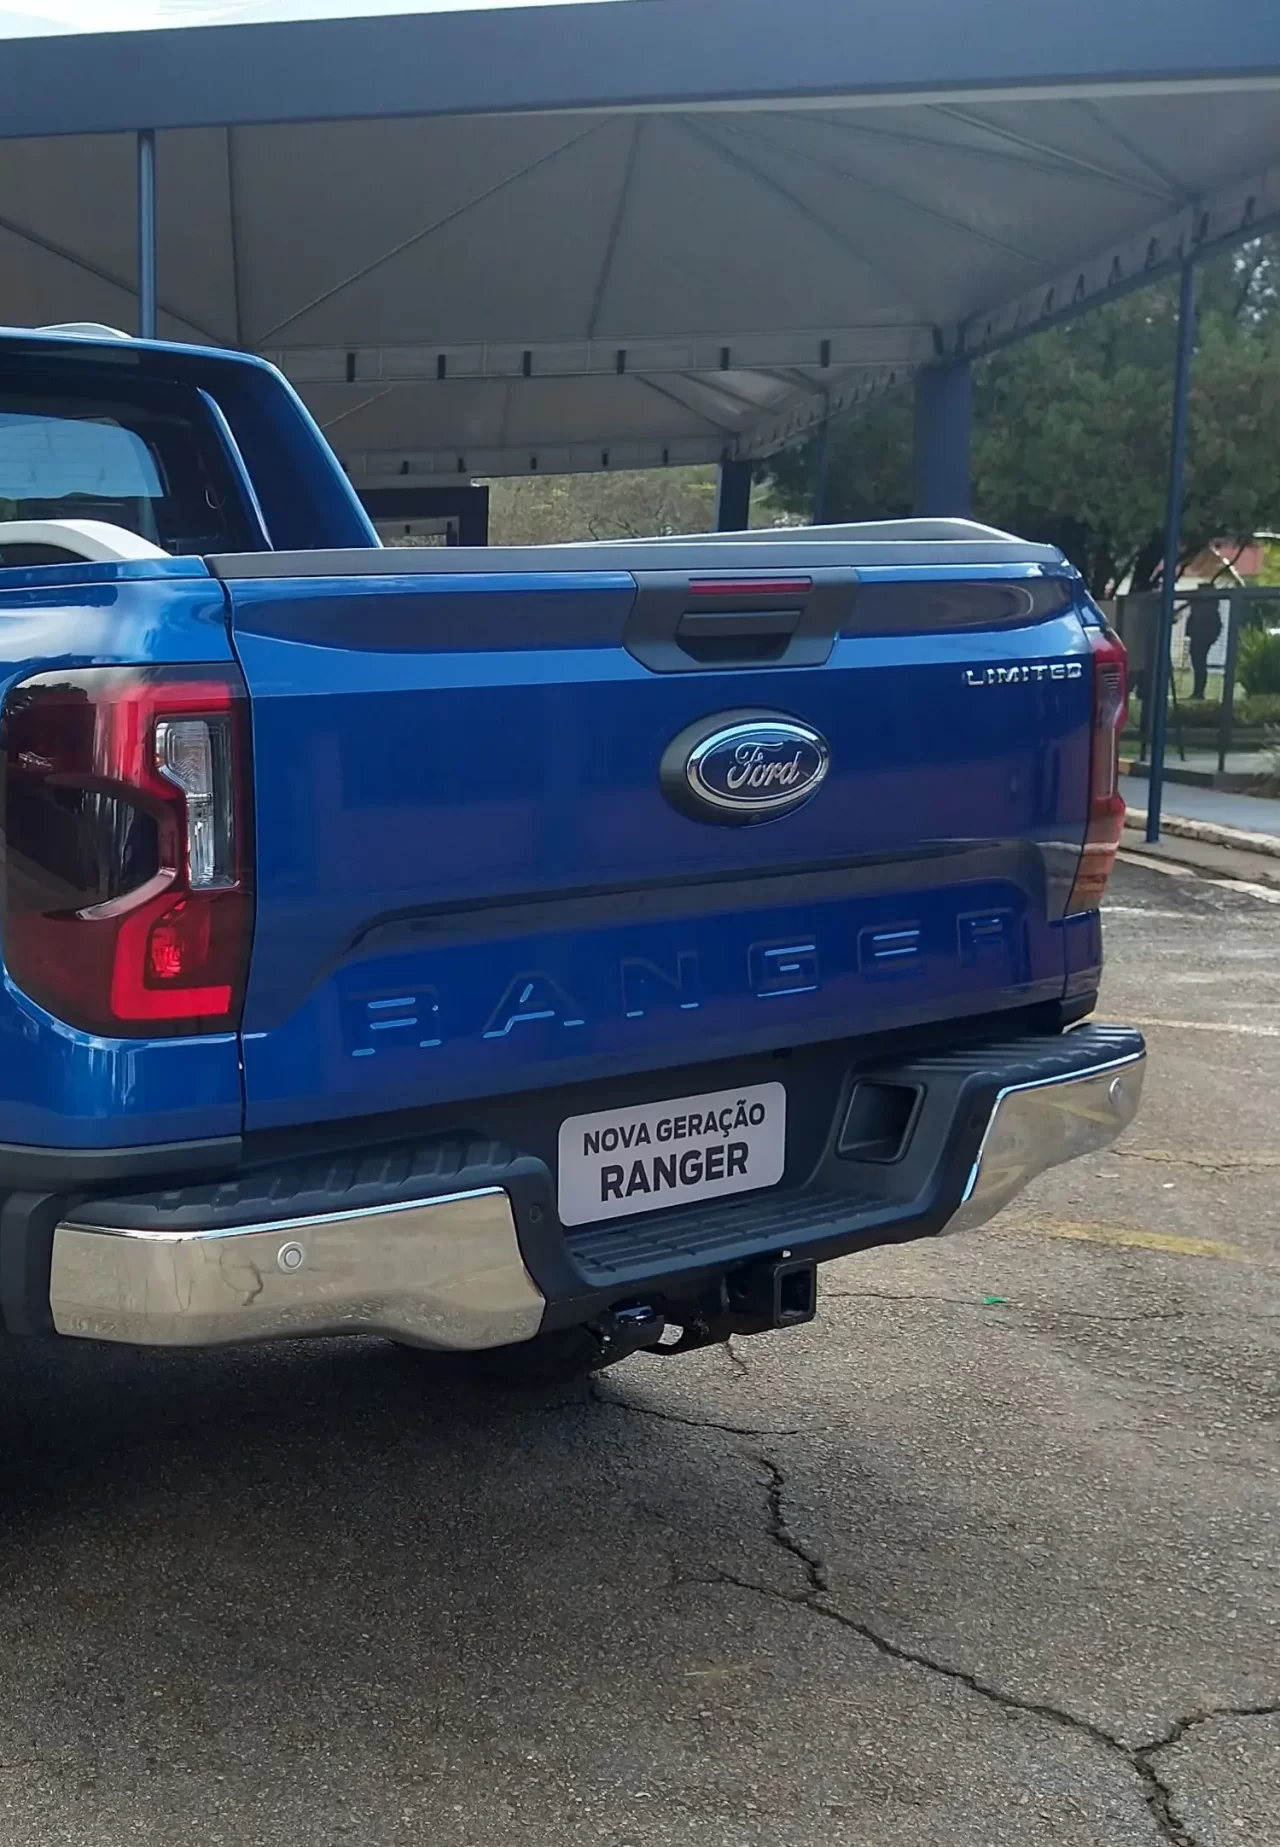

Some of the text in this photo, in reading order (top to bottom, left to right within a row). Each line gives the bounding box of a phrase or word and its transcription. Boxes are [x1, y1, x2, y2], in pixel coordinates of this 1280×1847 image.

[963, 663, 1082, 686] LIMITED
[726, 742, 802, 789] Ford
[342, 907, 1013, 1056] RANGER
[583, 1100, 765, 1156] NOVA GERAÇÃO
[600, 1142, 749, 1202] RANGER
